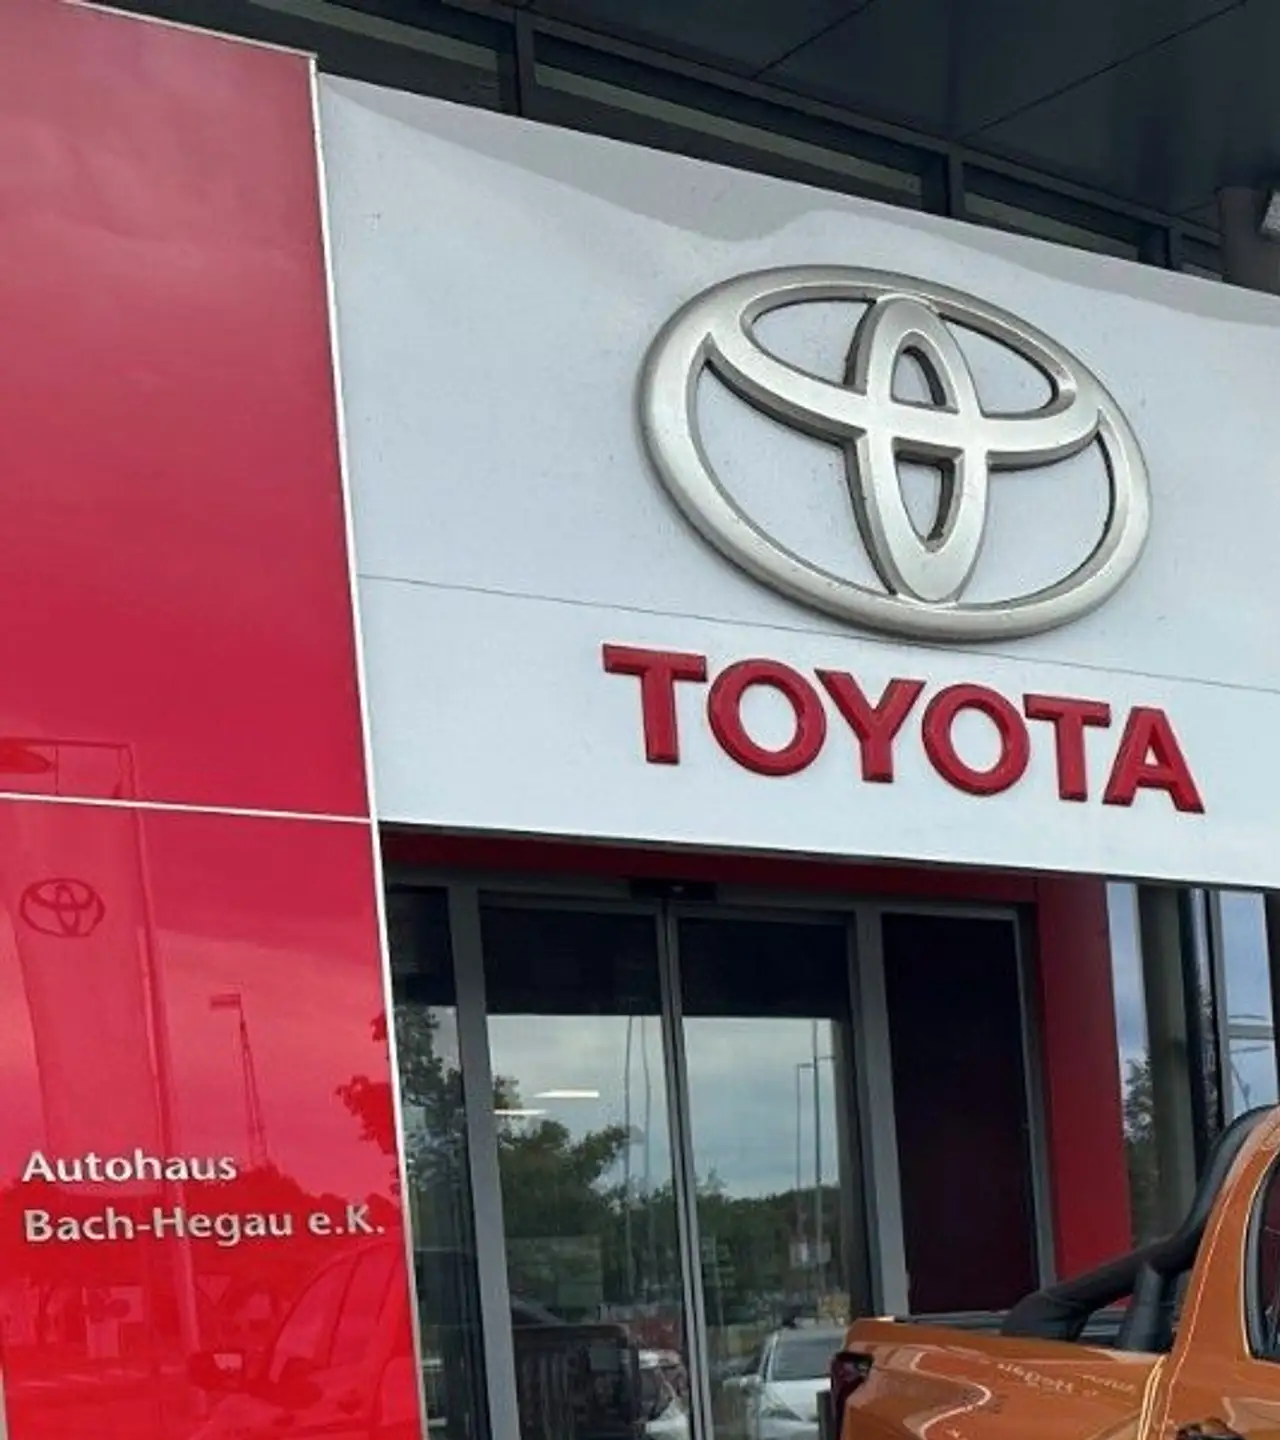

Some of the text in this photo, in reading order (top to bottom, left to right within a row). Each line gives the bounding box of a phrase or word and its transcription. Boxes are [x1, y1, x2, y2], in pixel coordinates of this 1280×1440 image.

[602, 643, 1206, 814] TOYOTA
[22, 1148, 238, 1183] Autohaus
[24, 1204, 386, 1246] Bach-Hegau e.K.
